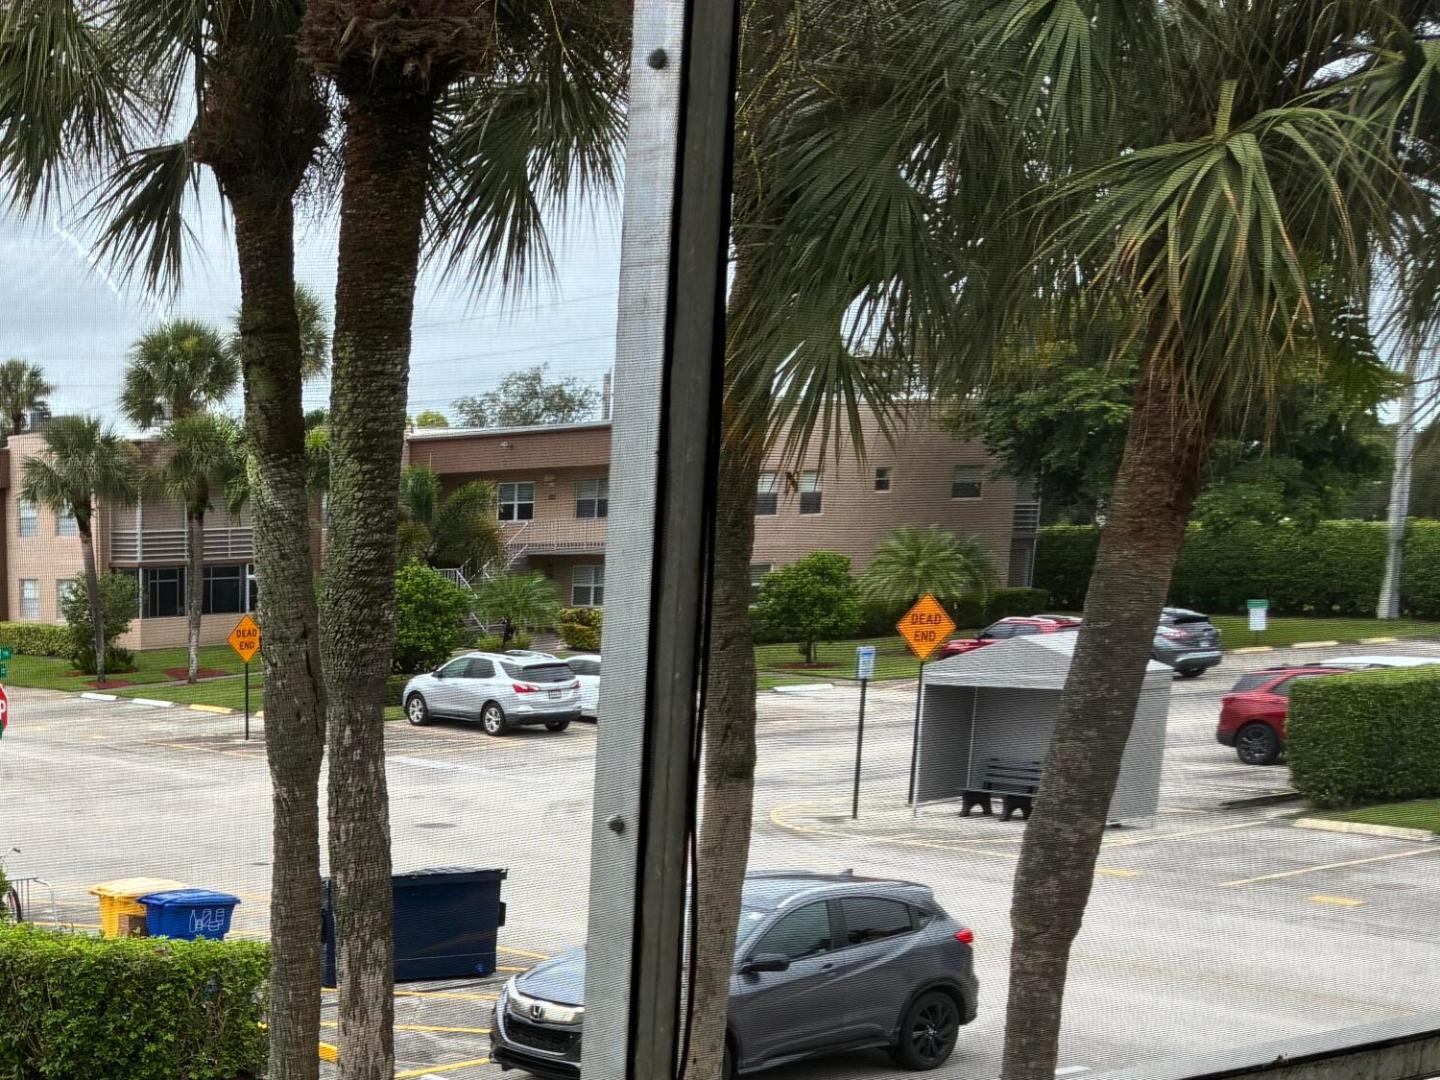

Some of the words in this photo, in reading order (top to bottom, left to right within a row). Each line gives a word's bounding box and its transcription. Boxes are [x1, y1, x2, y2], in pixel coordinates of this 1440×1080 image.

[911, 613, 941, 625] DEAD
[236, 629, 257, 639] DEAD
[913, 631, 936, 641] END
[239, 641, 255, 650] END
